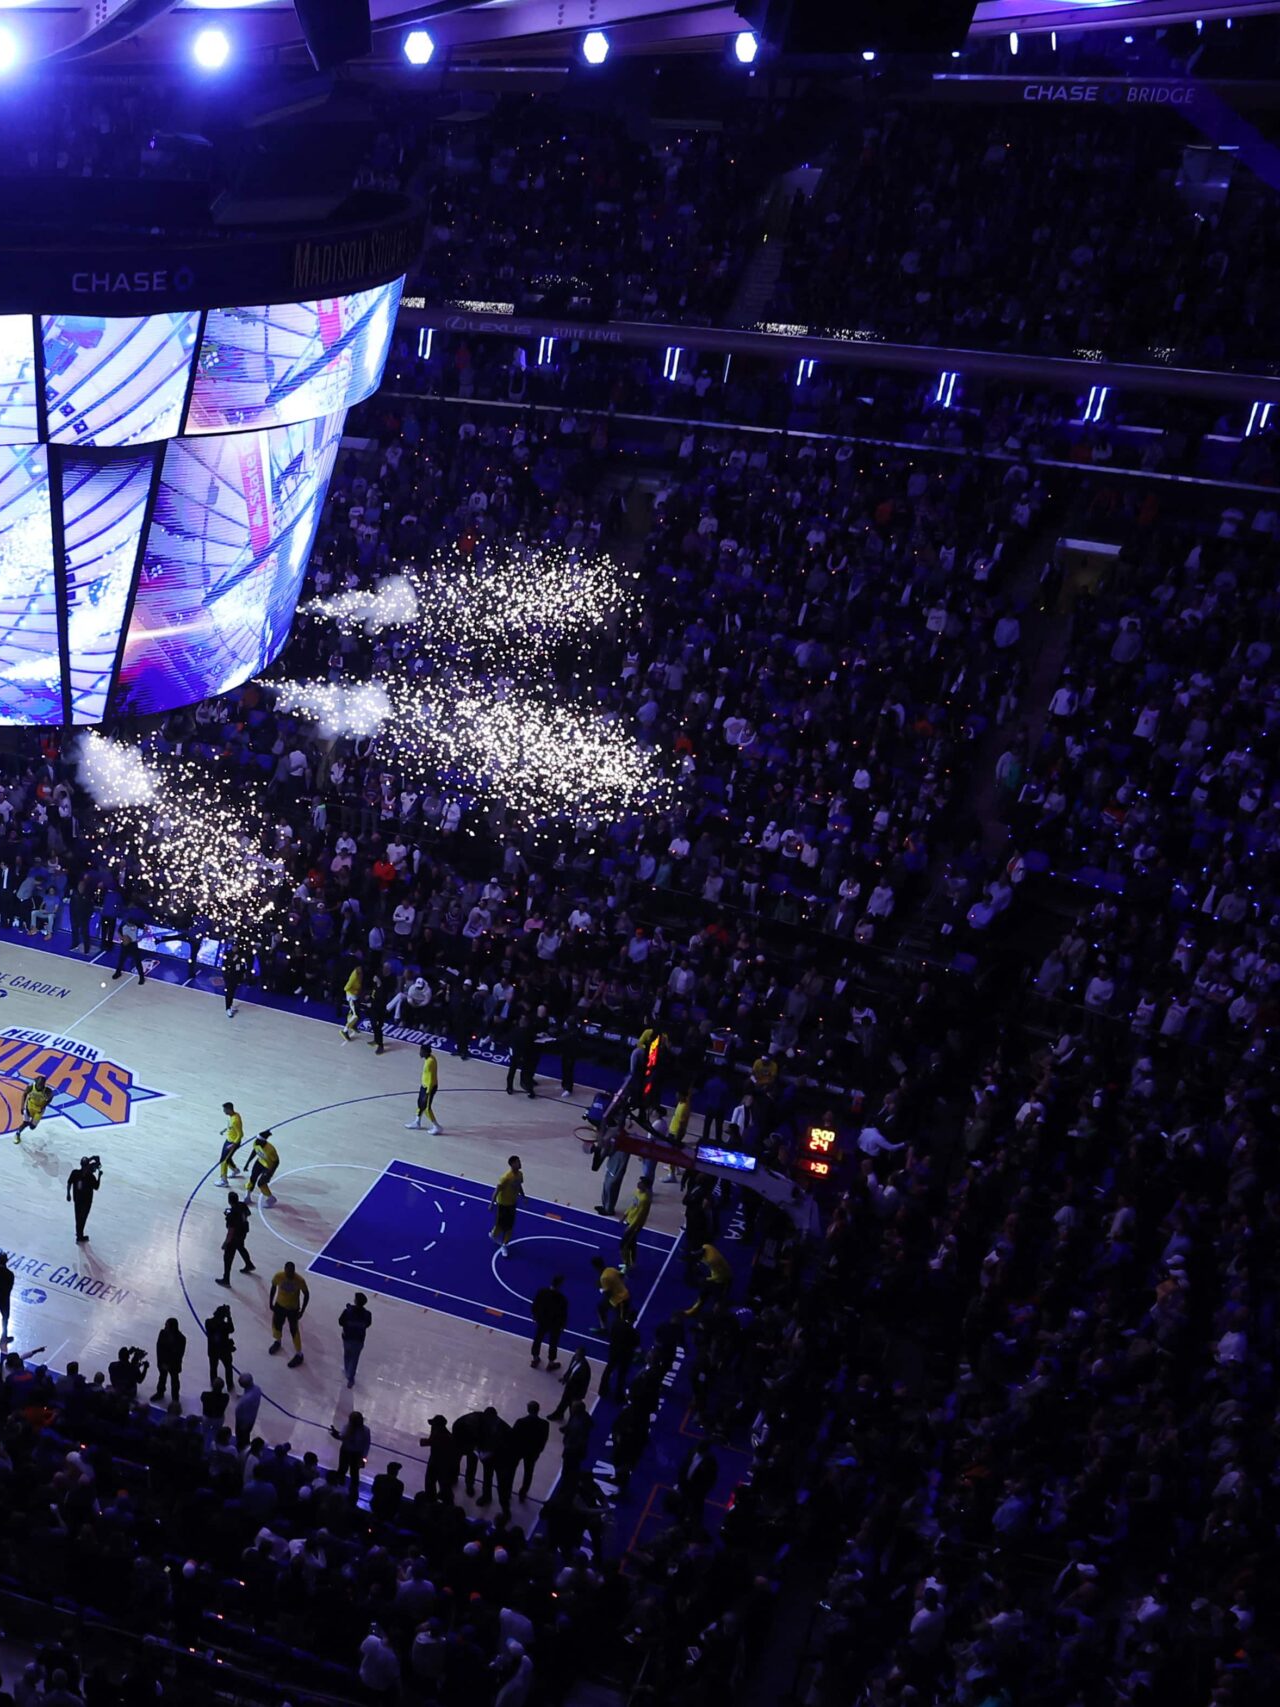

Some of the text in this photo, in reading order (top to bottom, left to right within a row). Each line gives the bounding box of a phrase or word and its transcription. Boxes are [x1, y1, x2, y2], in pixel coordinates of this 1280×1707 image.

[1023, 85, 1195, 103] CHASE BRIDGE
[293, 241, 366, 288] MADISON
[72, 270, 168, 294] CHASE
[469, 322, 532, 335] LEXUS
[552, 327, 623, 342] SUITE LEVEL
[9, 975, 72, 999] GARDEN
[1, 1027, 99, 1061] NEW YORK
[809, 1136, 828, 1151] 24
[48, 1266, 130, 1304] GARDEN
